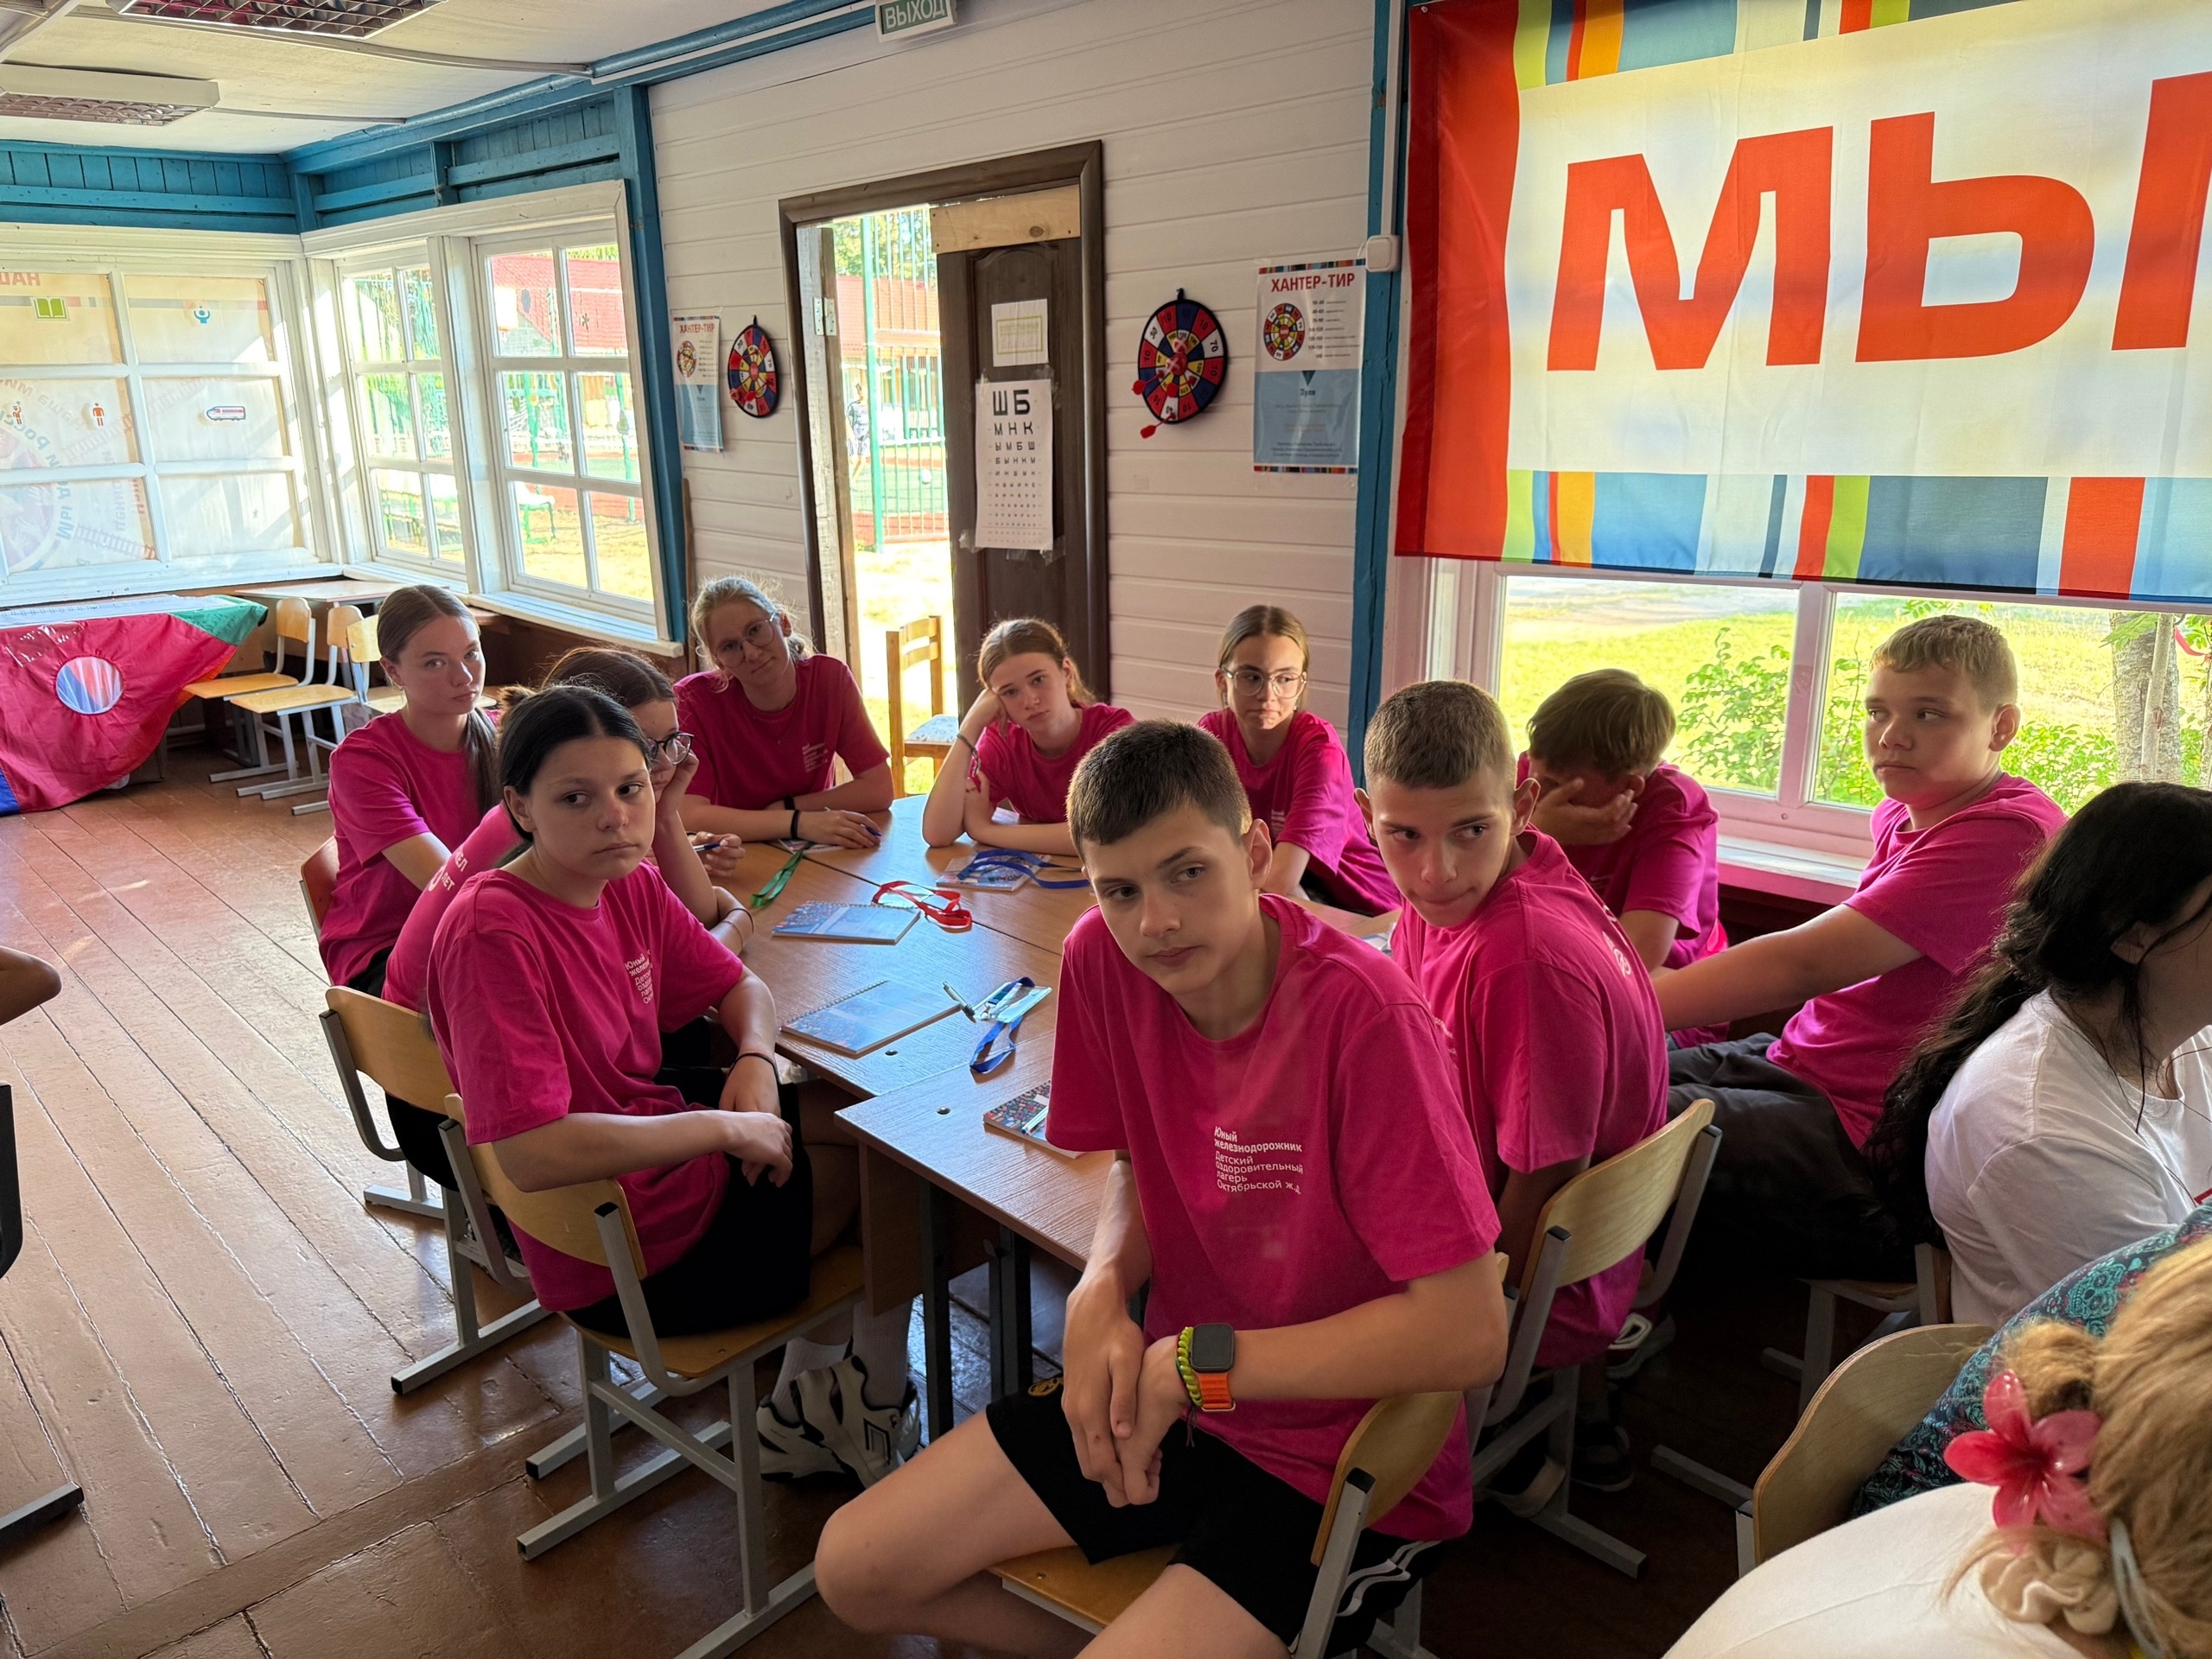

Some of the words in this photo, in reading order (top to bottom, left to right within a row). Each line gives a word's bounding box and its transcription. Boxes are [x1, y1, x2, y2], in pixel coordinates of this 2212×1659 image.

[885, 0, 945, 29] ВЫХОД
[1547, 71, 2212, 372] МЫ
[1271, 273, 1356, 292] ХАНТЕР-ТИР
[1200, 318, 1209, 330] 10
[1210, 339, 1219, 353] 70
[1211, 365, 1218, 377] 10
[625, 953, 646, 970] Юный
[1214, 1126, 1237, 1142] Юный
[1214, 1138, 1303, 1154] железнодорожник
[1215, 1150, 1254, 1166] Детский
[1215, 1160, 1304, 1175] оздоровительный
[1217, 1170, 1248, 1185] лагерь
[1217, 1179, 1282, 1192] Октябрьской
